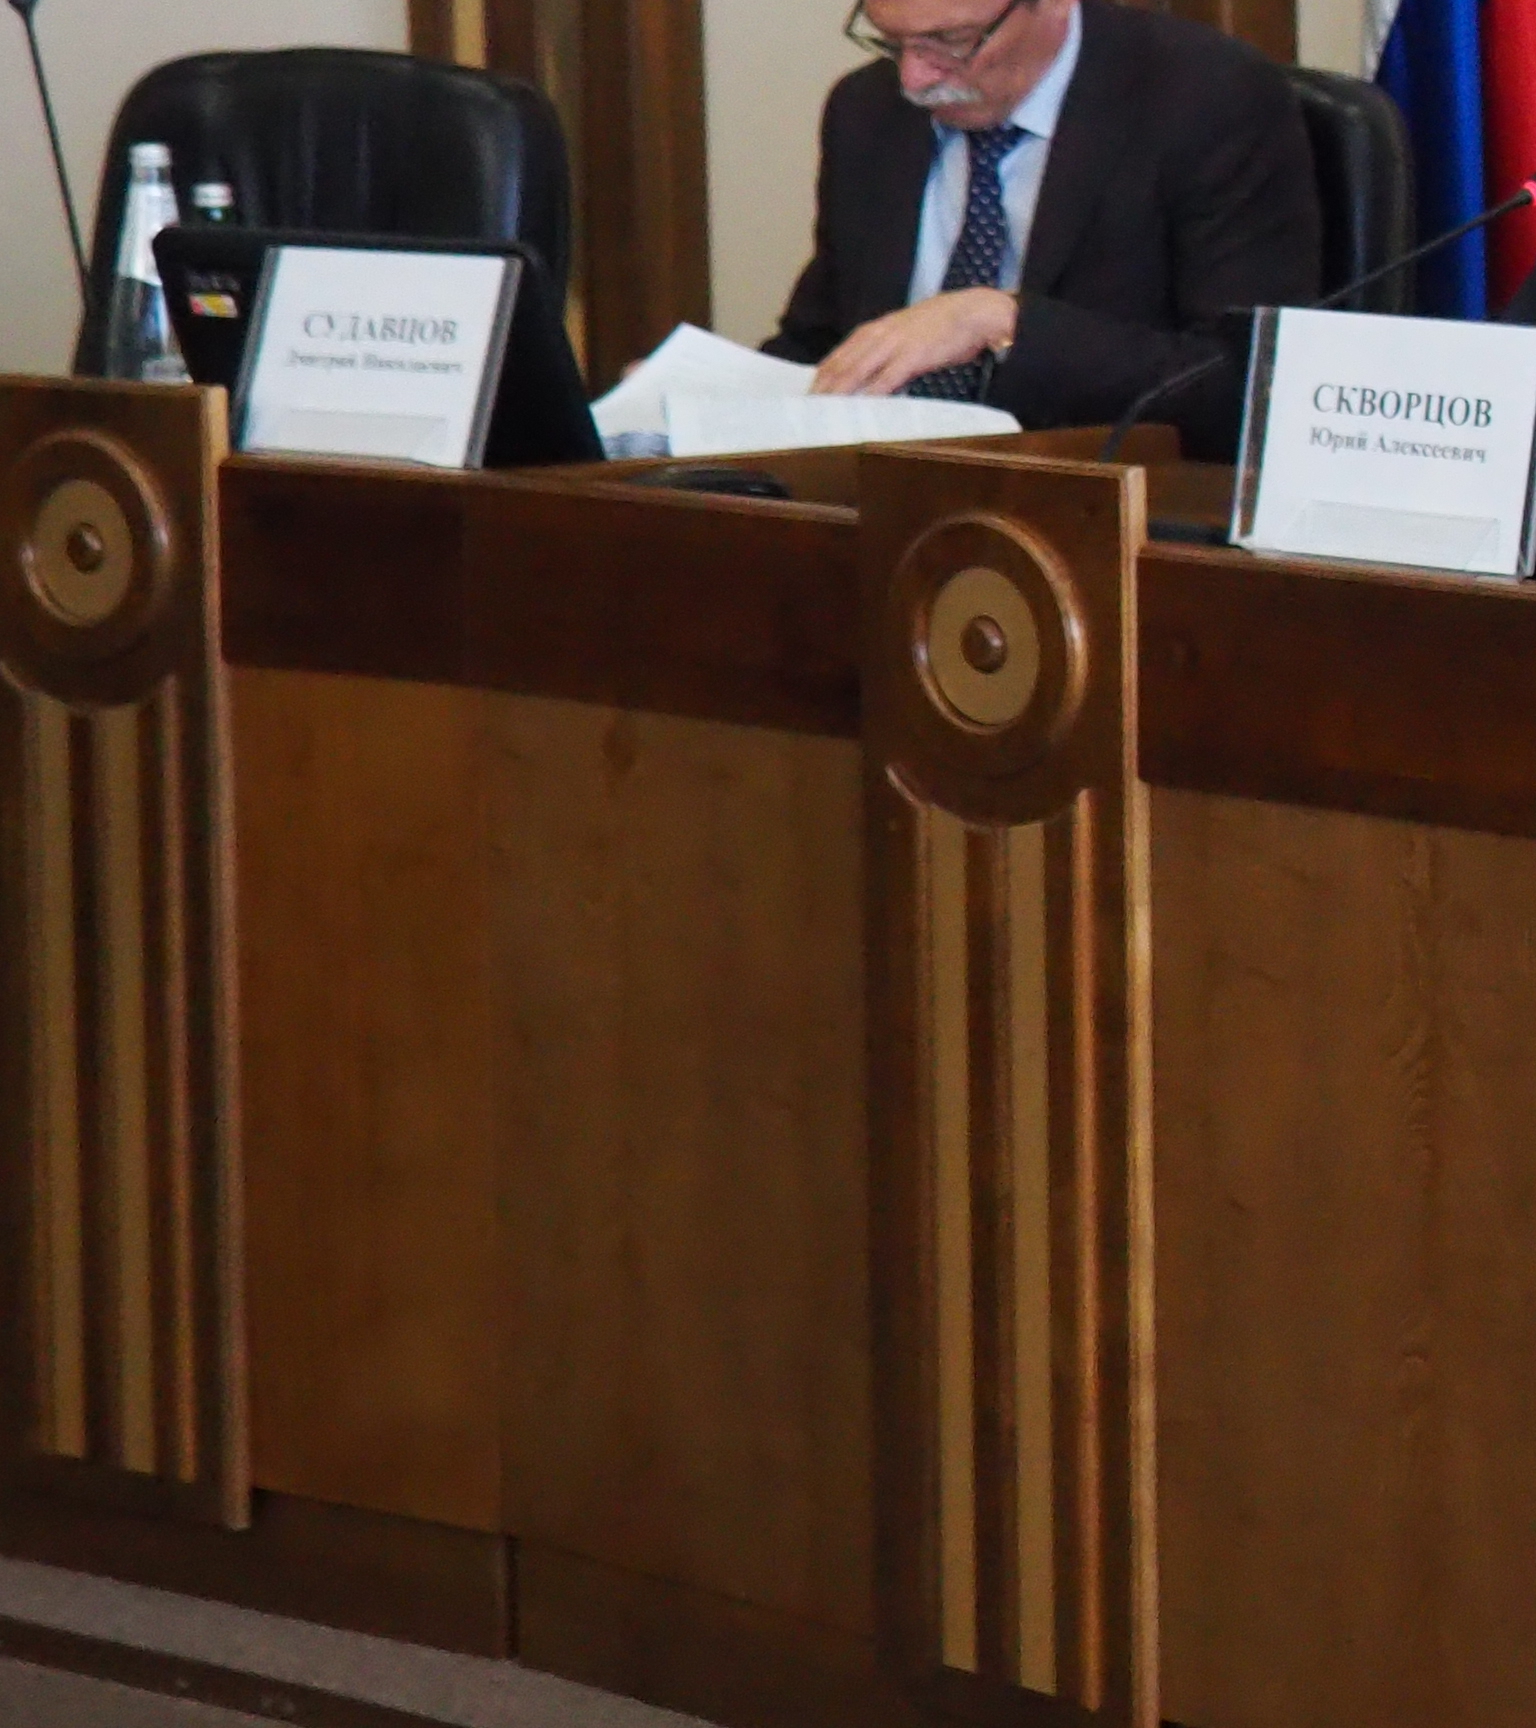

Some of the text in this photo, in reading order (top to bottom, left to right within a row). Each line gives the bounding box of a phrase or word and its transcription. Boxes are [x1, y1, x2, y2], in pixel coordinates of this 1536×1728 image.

[303, 313, 459, 345] СУДАВЦОВ
[1312, 383, 1493, 429] СКВОРЦОВ
[1309, 426, 1488, 465] Юрий Алексеевич
